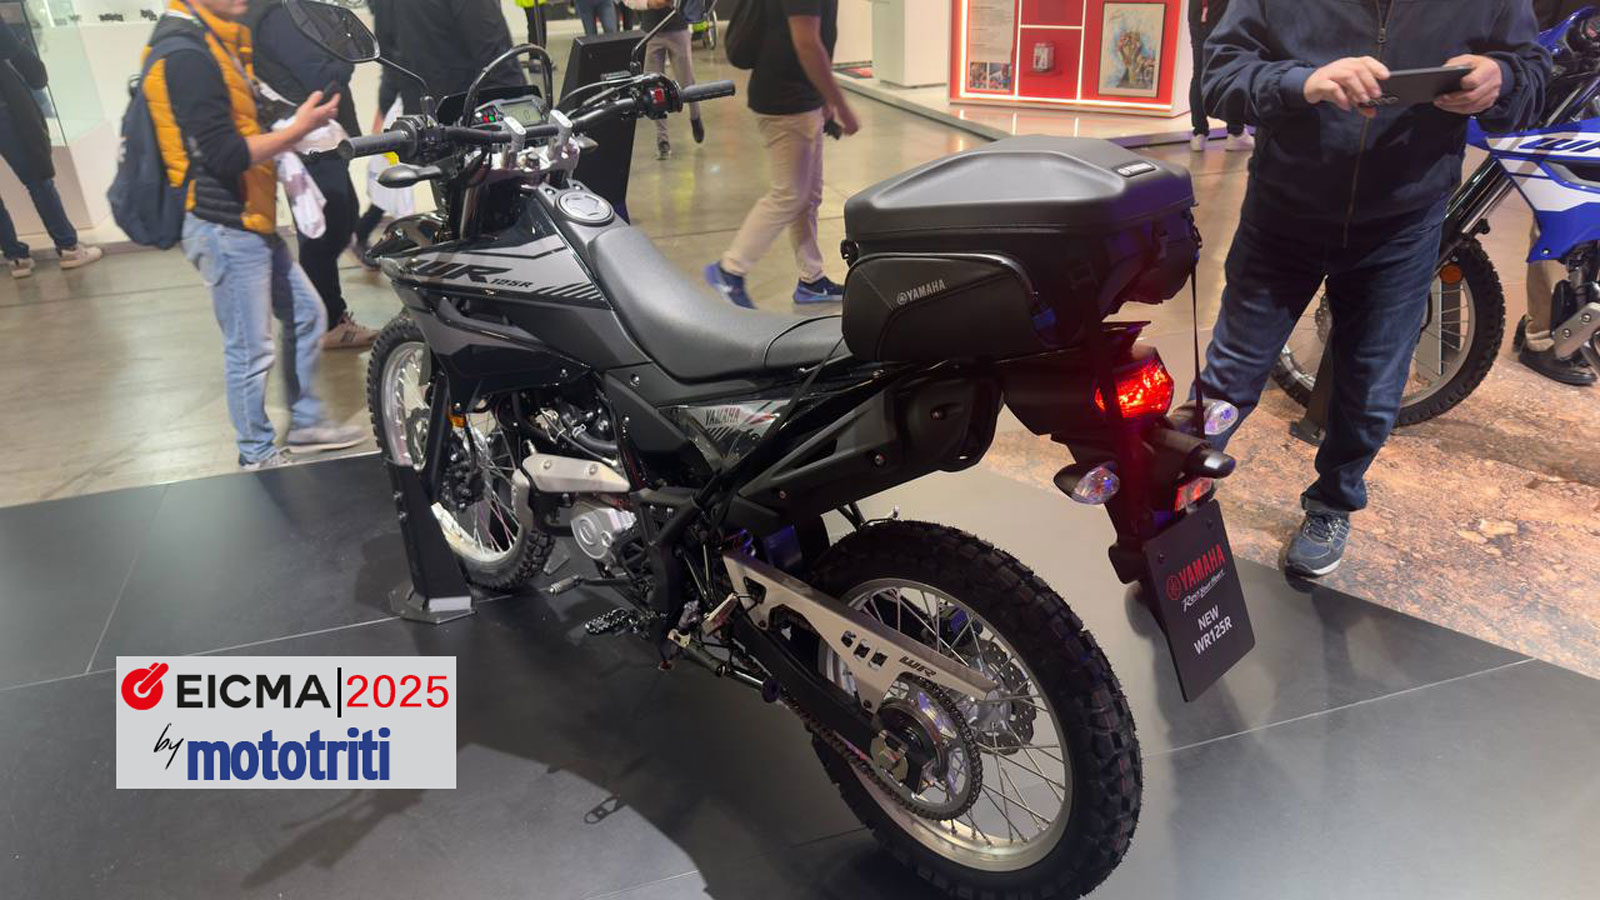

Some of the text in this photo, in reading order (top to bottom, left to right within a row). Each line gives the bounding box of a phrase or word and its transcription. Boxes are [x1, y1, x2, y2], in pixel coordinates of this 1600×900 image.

[906, 279, 946, 301] YAMAHA
[705, 407, 741, 426] YAMAHA
[1178, 543, 1226, 594] YAMAHA
[1197, 604, 1219, 631] NEW
[1193, 615, 1233, 655] WR125R
